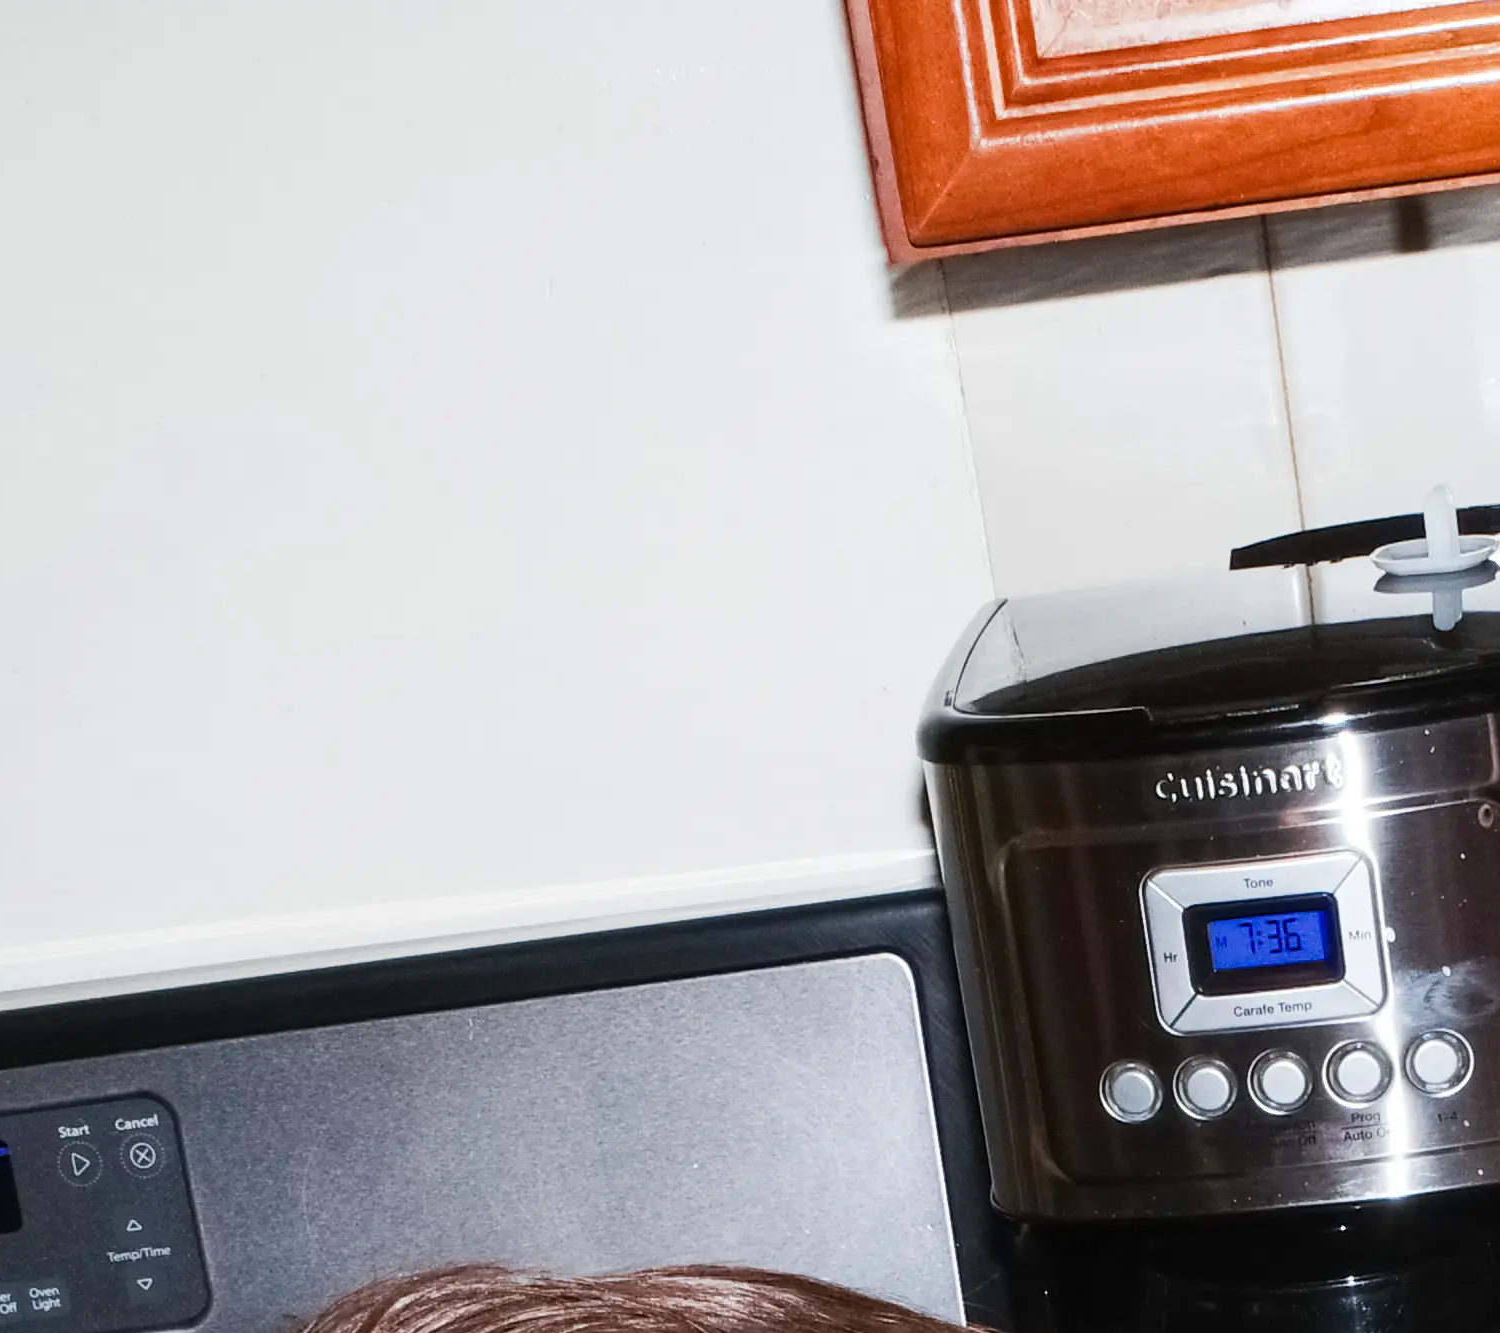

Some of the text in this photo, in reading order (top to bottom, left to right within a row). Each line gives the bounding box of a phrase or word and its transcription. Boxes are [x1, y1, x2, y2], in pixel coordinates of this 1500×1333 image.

[1243, 878, 1274, 889] Tone
[1238, 918, 1302, 954] 7:36
[1349, 930, 1372, 941] Min
[1163, 951, 1178, 963] Hr
[1233, 1001, 1313, 1018] Carafe Temp
[115, 1114, 159, 1131] Cancel
[58, 1125, 91, 1139] Start
[1343, 1129, 1372, 1142] Auto
[107, 1246, 172, 1263] Temp/Time
[29, 1287, 60, 1298] Oven
[32, 1297, 62, 1312] Light
